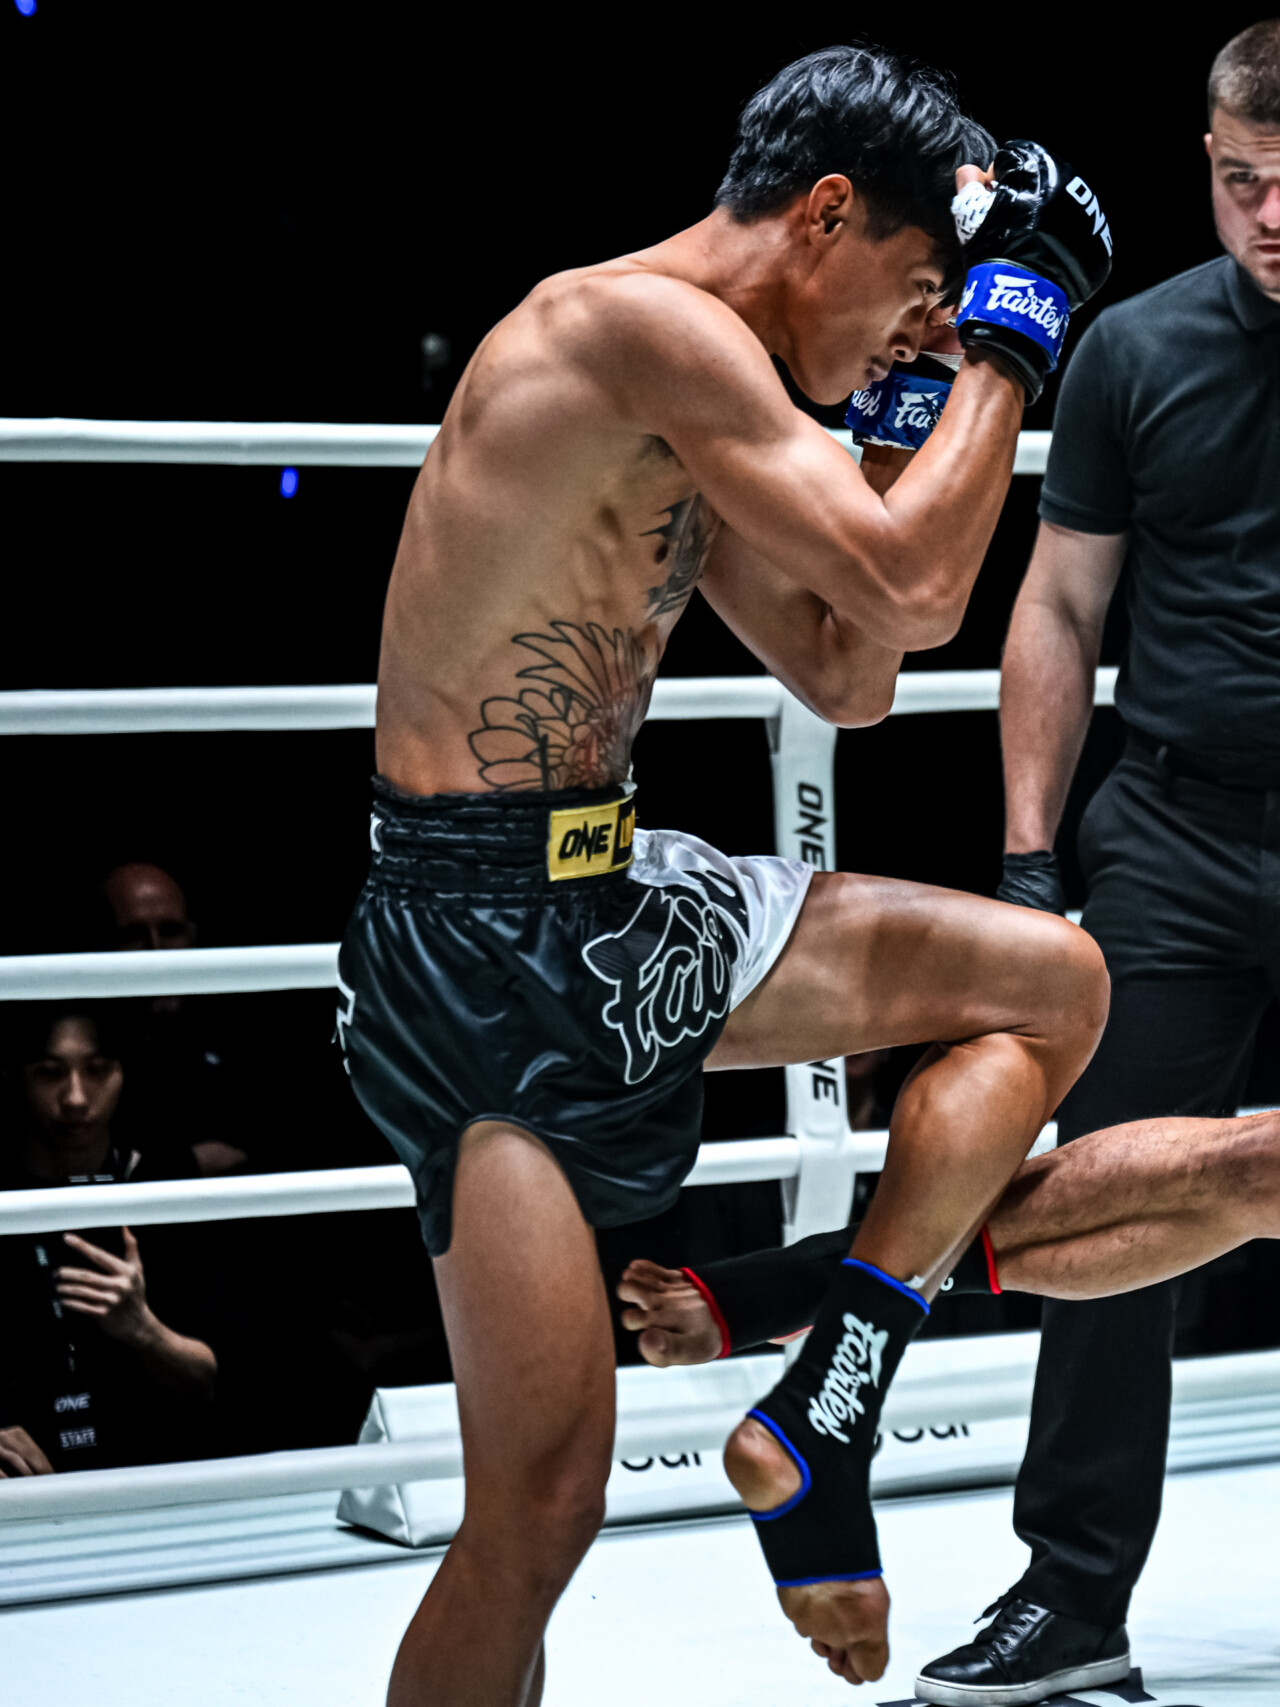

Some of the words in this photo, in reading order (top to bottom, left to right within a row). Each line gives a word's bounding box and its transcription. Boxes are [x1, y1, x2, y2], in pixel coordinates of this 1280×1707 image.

[986, 274, 1064, 339] Fairtex
[558, 820, 612, 863] ONE
[793, 782, 828, 872] ONE
[806, 1060, 839, 1107] NE
[808, 1312, 889, 1444] Fairtex
[54, 1393, 91, 1412] ONE
[60, 1429, 97, 1448] STAFF
